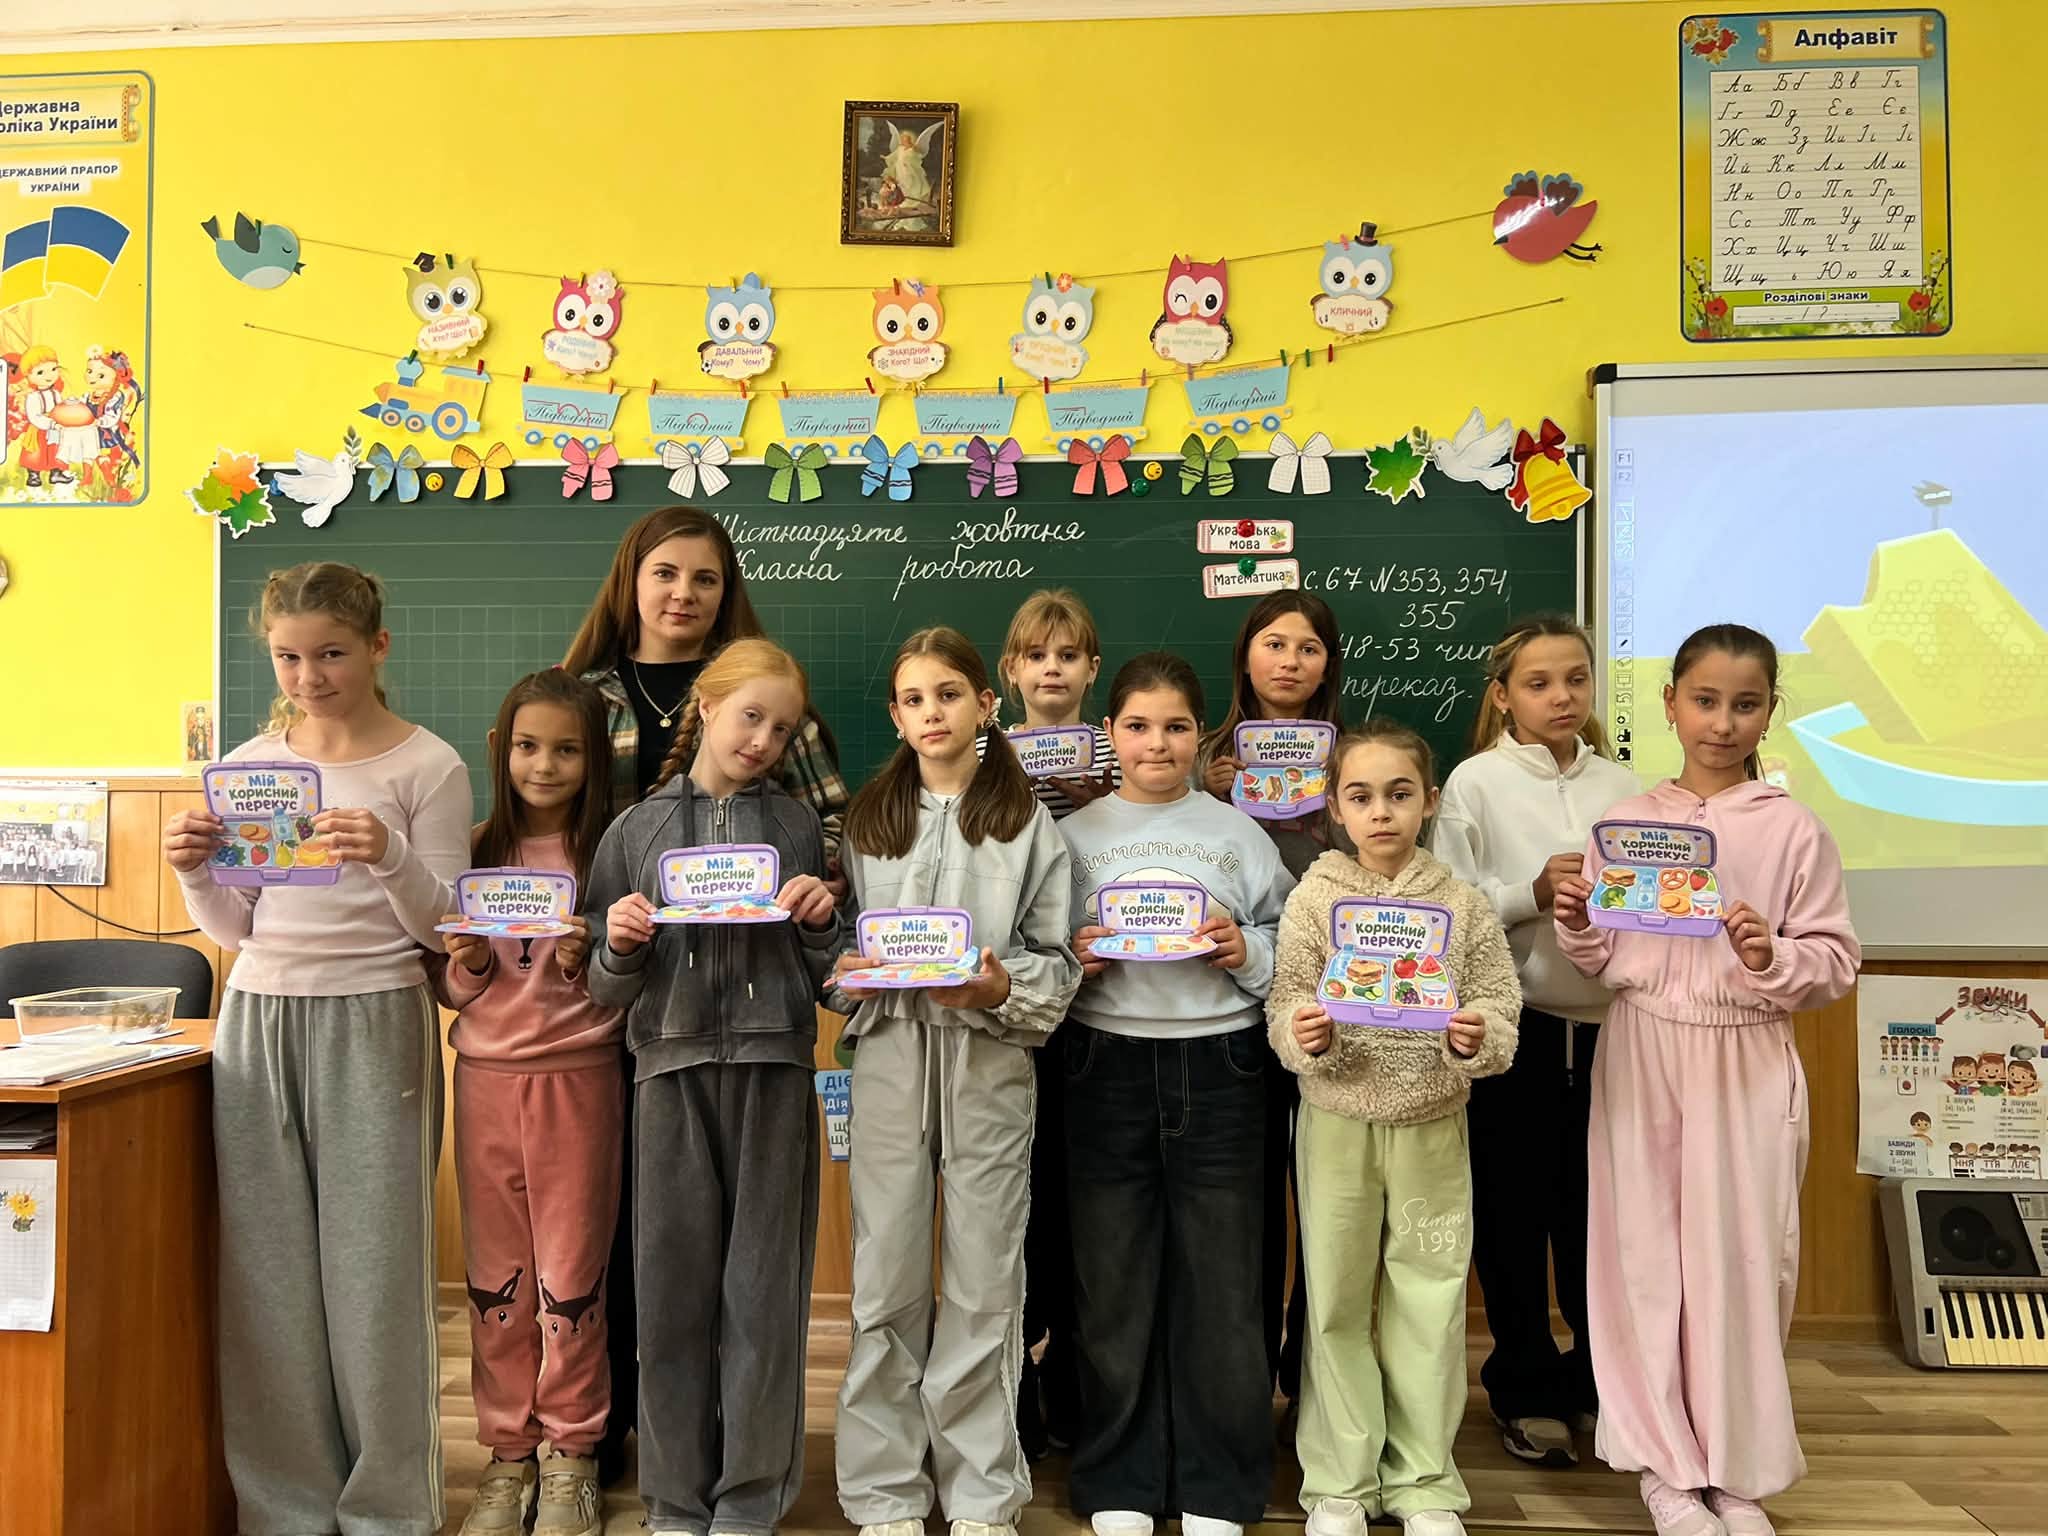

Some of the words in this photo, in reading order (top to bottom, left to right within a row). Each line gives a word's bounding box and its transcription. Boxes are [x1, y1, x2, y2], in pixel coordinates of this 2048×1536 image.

[1794, 27, 1898, 50] Алфавіт
[49, 116, 118, 134] України
[71, 165, 118, 175] ПРАПОР
[31, 182, 80, 192] УКРАЇНИ
[1764, 293, 1826, 304] Розділові
[1829, 291, 1869, 302] знаки
[1330, 307, 1373, 316] КЛИЧНИЙ
[715, 348, 762, 356] ДАВАЛЬНИЙ
[710, 359, 734, 368] Кому?
[743, 358, 765, 367] Чому?
[1198, 391, 1278, 414] Підводний
[528, 404, 604, 425] Підводний
[1055, 409, 1135, 431] Підводний
[656, 414, 733, 436] Підводний
[790, 416, 866, 437] Підводний
[924, 414, 1001, 436] Підводний
[1618, 453, 1631, 463] F1
[1618, 471, 1632, 481] F2
[712, 512, 907, 560] Шістнадцяте
[951, 506, 1086, 543] жовтня
[1229, 540, 1260, 549] мова
[736, 548, 842, 581] Класна
[893, 541, 1034, 601] робота
[1214, 571, 1285, 586] Математика
[1325, 566, 1362, 592] 67
[1400, 601, 1464, 630] 355
[1339, 633, 1420, 661] 48-53
[1274, 731, 1297, 741] Мій
[1036, 737, 1059, 749] Мій
[1260, 750, 1312, 760] перекус
[1025, 757, 1075, 770] перекус
[248, 775, 276, 787] Мій
[234, 800, 297, 812] перекус
[1640, 831, 1669, 842] Мій
[1627, 850, 1689, 861] перекус
[707, 857, 733, 871] Мій
[1071, 841, 1240, 885] Cinnamoroll
[503, 879, 531, 891] Мій
[691, 880, 752, 895] перекус
[1140, 893, 1165, 904] Мій
[488, 903, 549, 915] перекус
[1125, 915, 1182, 927] перекус
[1378, 912, 1406, 924] Мій
[902, 920, 928, 932] Мій
[1360, 935, 1422, 949] перекус
[887, 944, 945, 956] перекус
